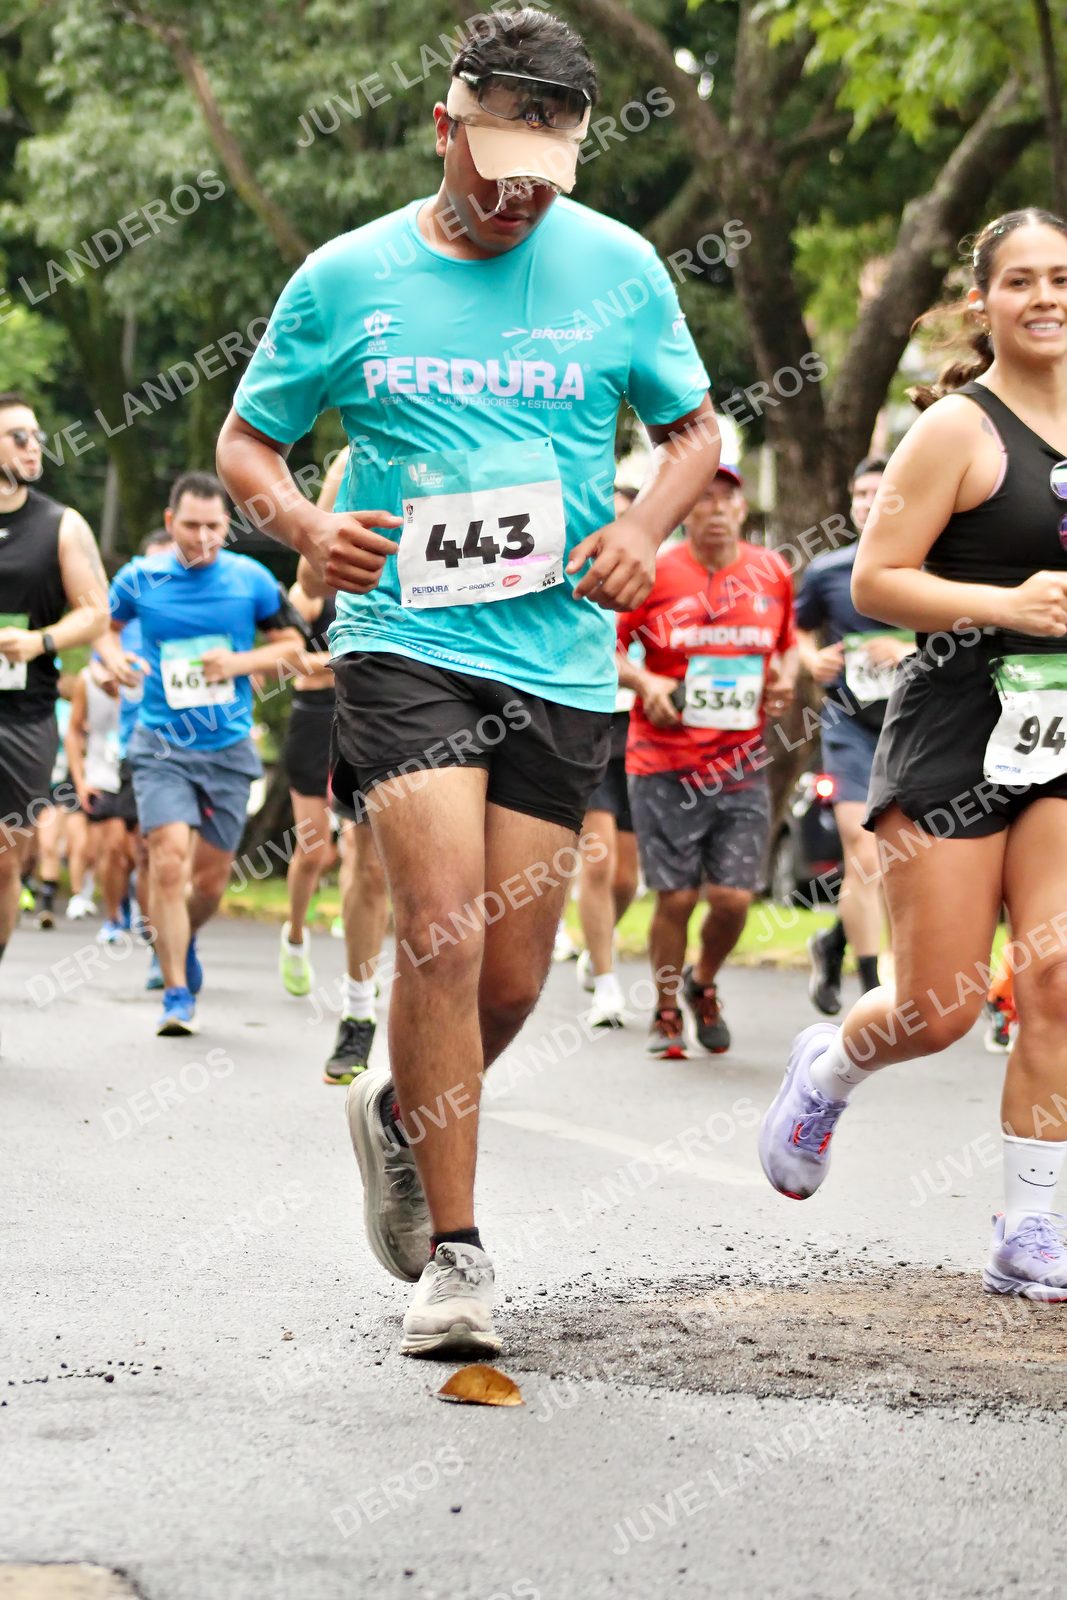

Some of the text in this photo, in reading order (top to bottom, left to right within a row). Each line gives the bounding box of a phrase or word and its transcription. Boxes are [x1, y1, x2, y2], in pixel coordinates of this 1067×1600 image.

[530, 327, 594, 341] BROOKS
[363, 356, 585, 401] PERDURA
[527, 401, 573, 411] ESTUCOS
[425, 513, 535, 568] 443
[411, 585, 449, 595] PERDURA
[468, 581, 495, 591] BROOKS
[690, 689, 757, 711] 5349
[1014, 715, 1066, 756] 94
